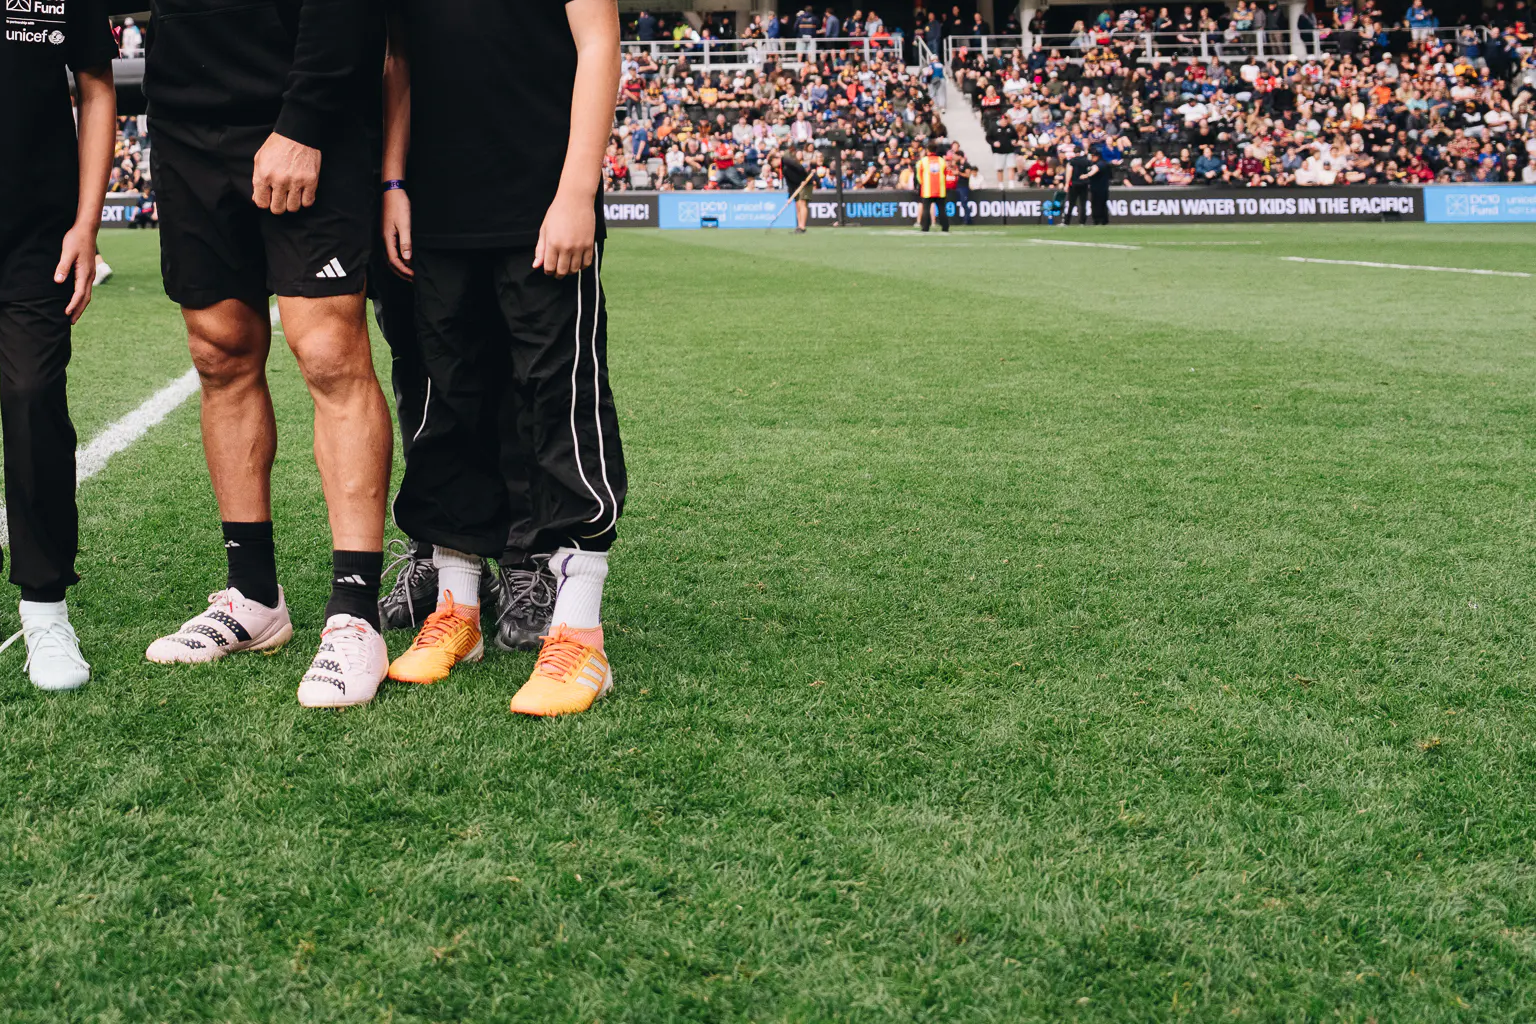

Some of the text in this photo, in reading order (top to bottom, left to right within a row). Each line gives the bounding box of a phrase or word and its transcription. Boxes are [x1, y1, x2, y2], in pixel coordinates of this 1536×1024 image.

[34, 1, 65, 14] Fund
[5, 28, 48, 43] unicef
[102, 206, 124, 221] EXT
[846, 202, 898, 217] UNICEF
[899, 201, 920, 217] TO
[979, 201, 1041, 217] DONATE
[1130, 200, 1180, 216] CLEAN
[1181, 199, 1235, 215] WATER
[1236, 198, 1258, 214] TO
[1259, 198, 1296, 214] KIDS
[1298, 198, 1316, 214] IN
[1317, 198, 1349, 214] THE
[1350, 197, 1414, 214] PACIFIC!
